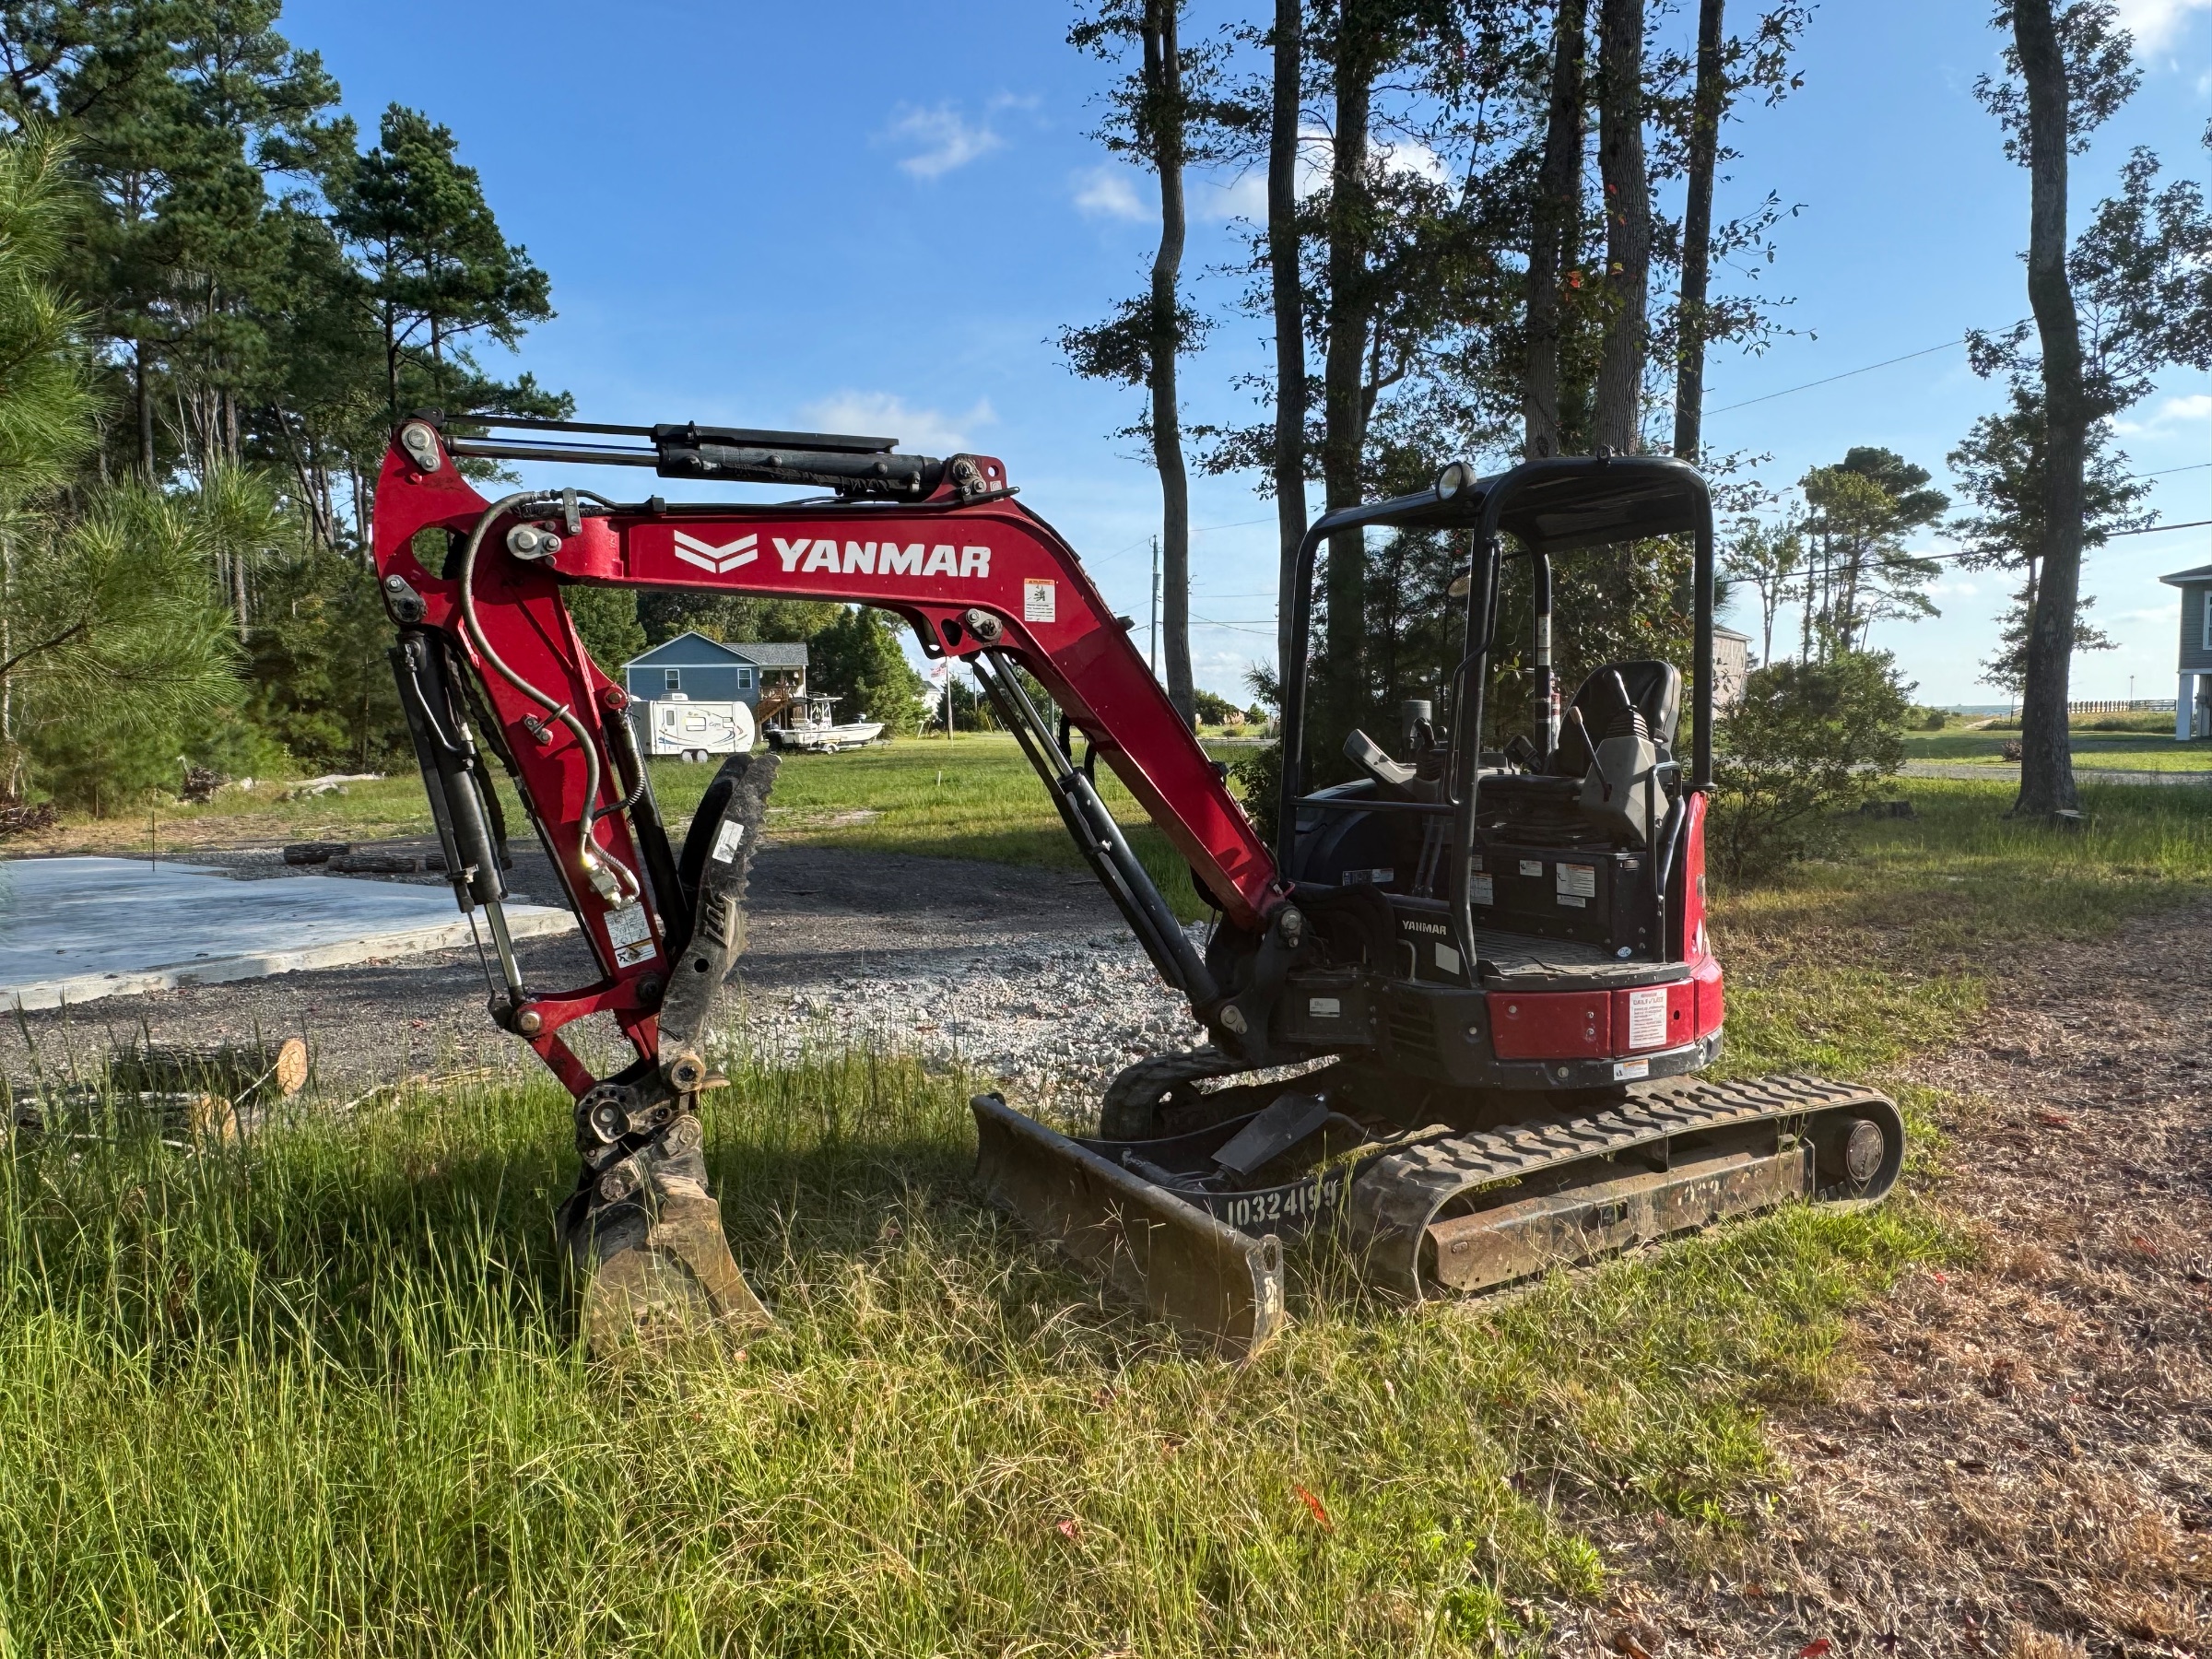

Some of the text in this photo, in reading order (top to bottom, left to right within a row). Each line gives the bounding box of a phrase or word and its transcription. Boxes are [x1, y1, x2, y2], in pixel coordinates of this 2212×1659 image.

[771, 537, 991, 578] YANMAR
[1402, 920, 1447, 935] YANMAR
[1228, 1180, 1336, 1228] 10324199
